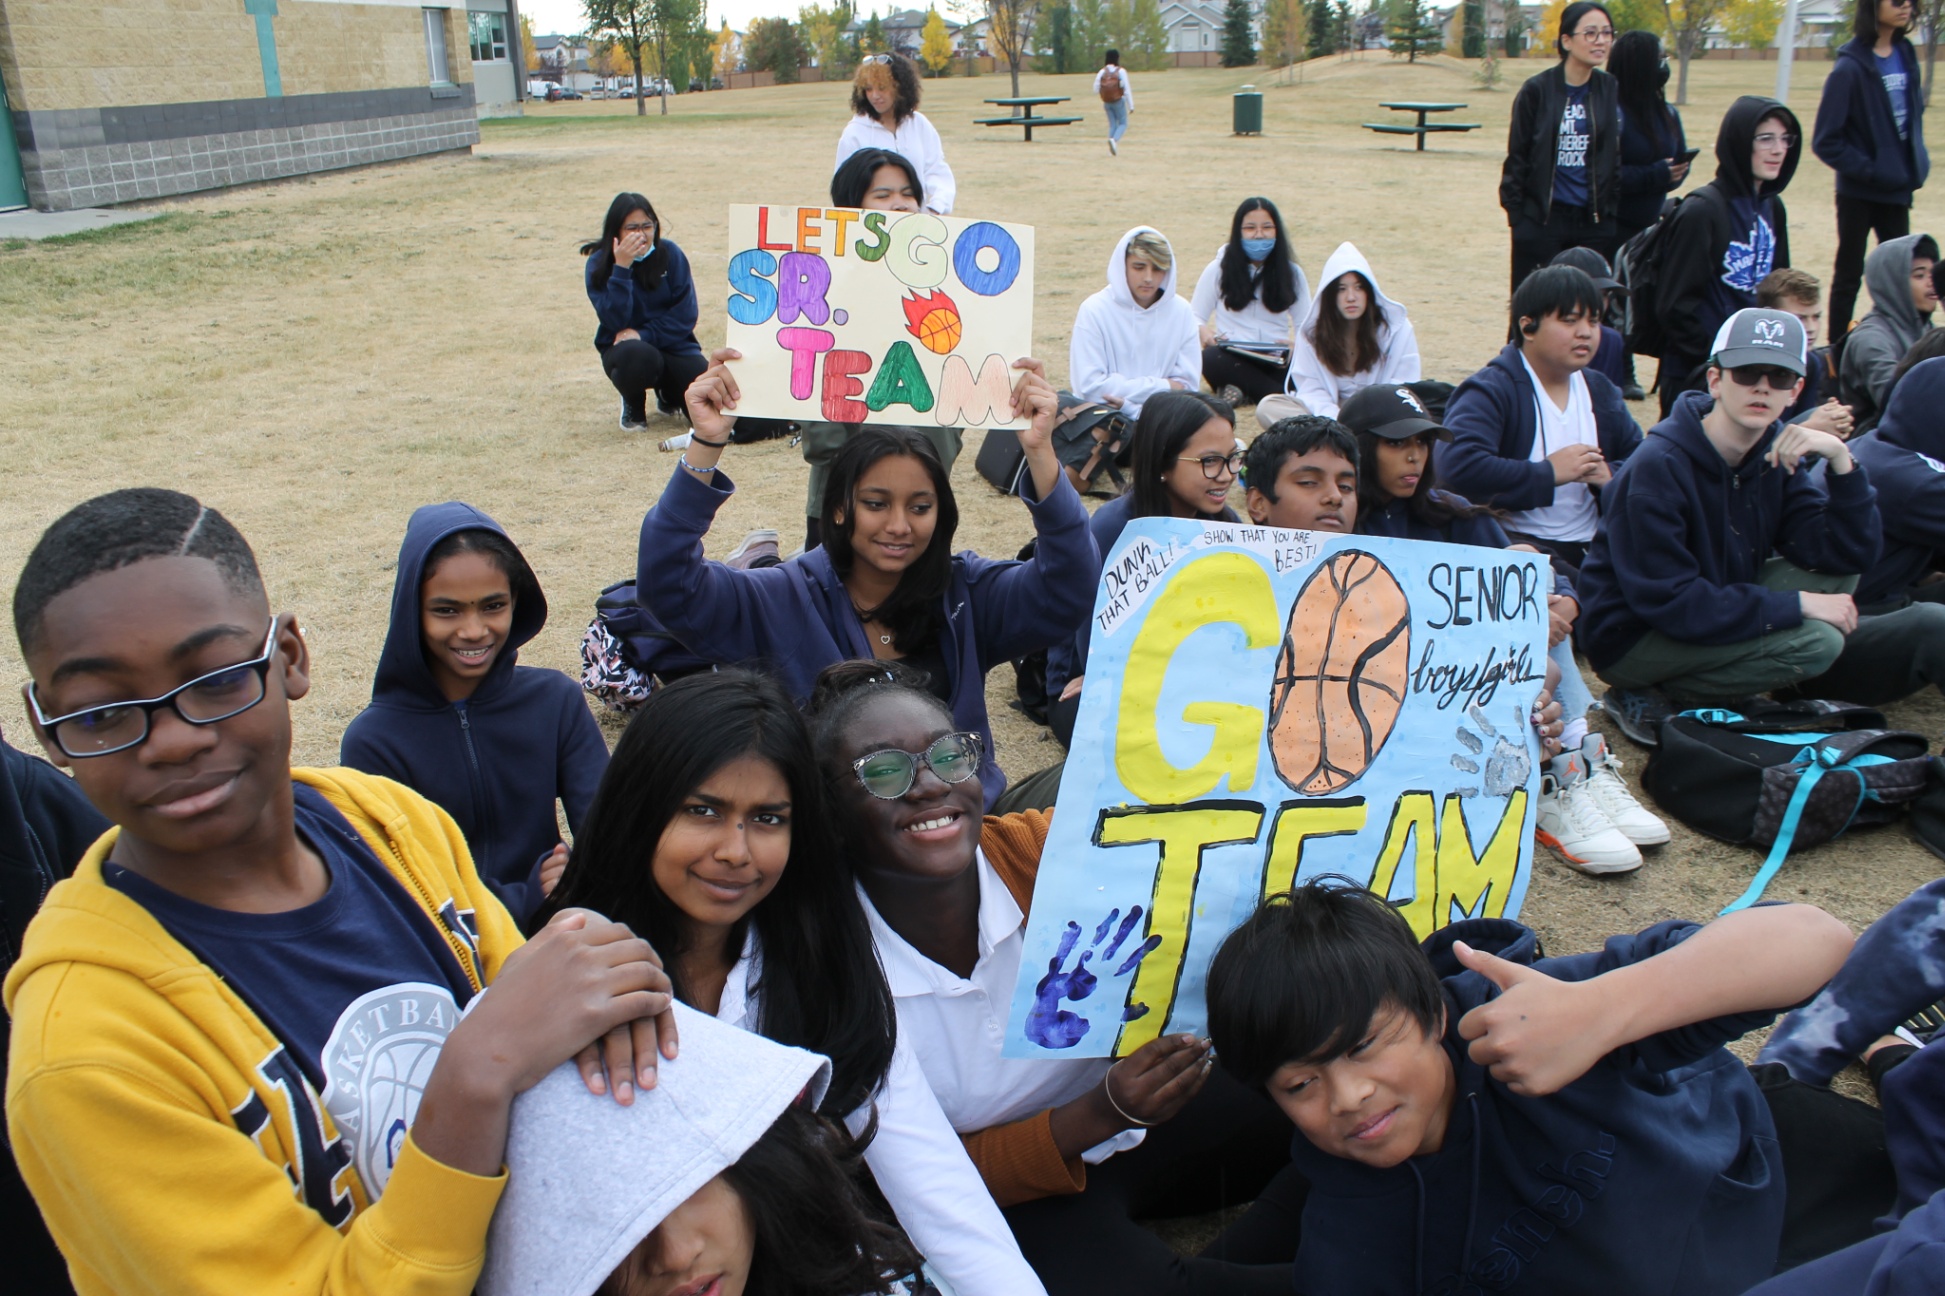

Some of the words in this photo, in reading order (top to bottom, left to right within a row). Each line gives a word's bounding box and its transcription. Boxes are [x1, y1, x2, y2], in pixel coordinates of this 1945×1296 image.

[1557, 151, 1586, 167] ROCK
[727, 248, 849, 326] SR.
[884, 213, 1021, 297] GO
[776, 326, 1016, 427] TEAM
[1105, 541, 1151, 600] DUNK
[1204, 528, 1234, 545] SHOW
[1240, 528, 1267, 543] THAT
[1272, 530, 1291, 545] YOU
[1293, 531, 1312, 544] ARE
[1274, 544, 1317, 573] BEST!
[1096, 589, 1130, 631] THAT
[1135, 542, 1174, 594] BALL!
[1427, 561, 1541, 631] SENIOR
